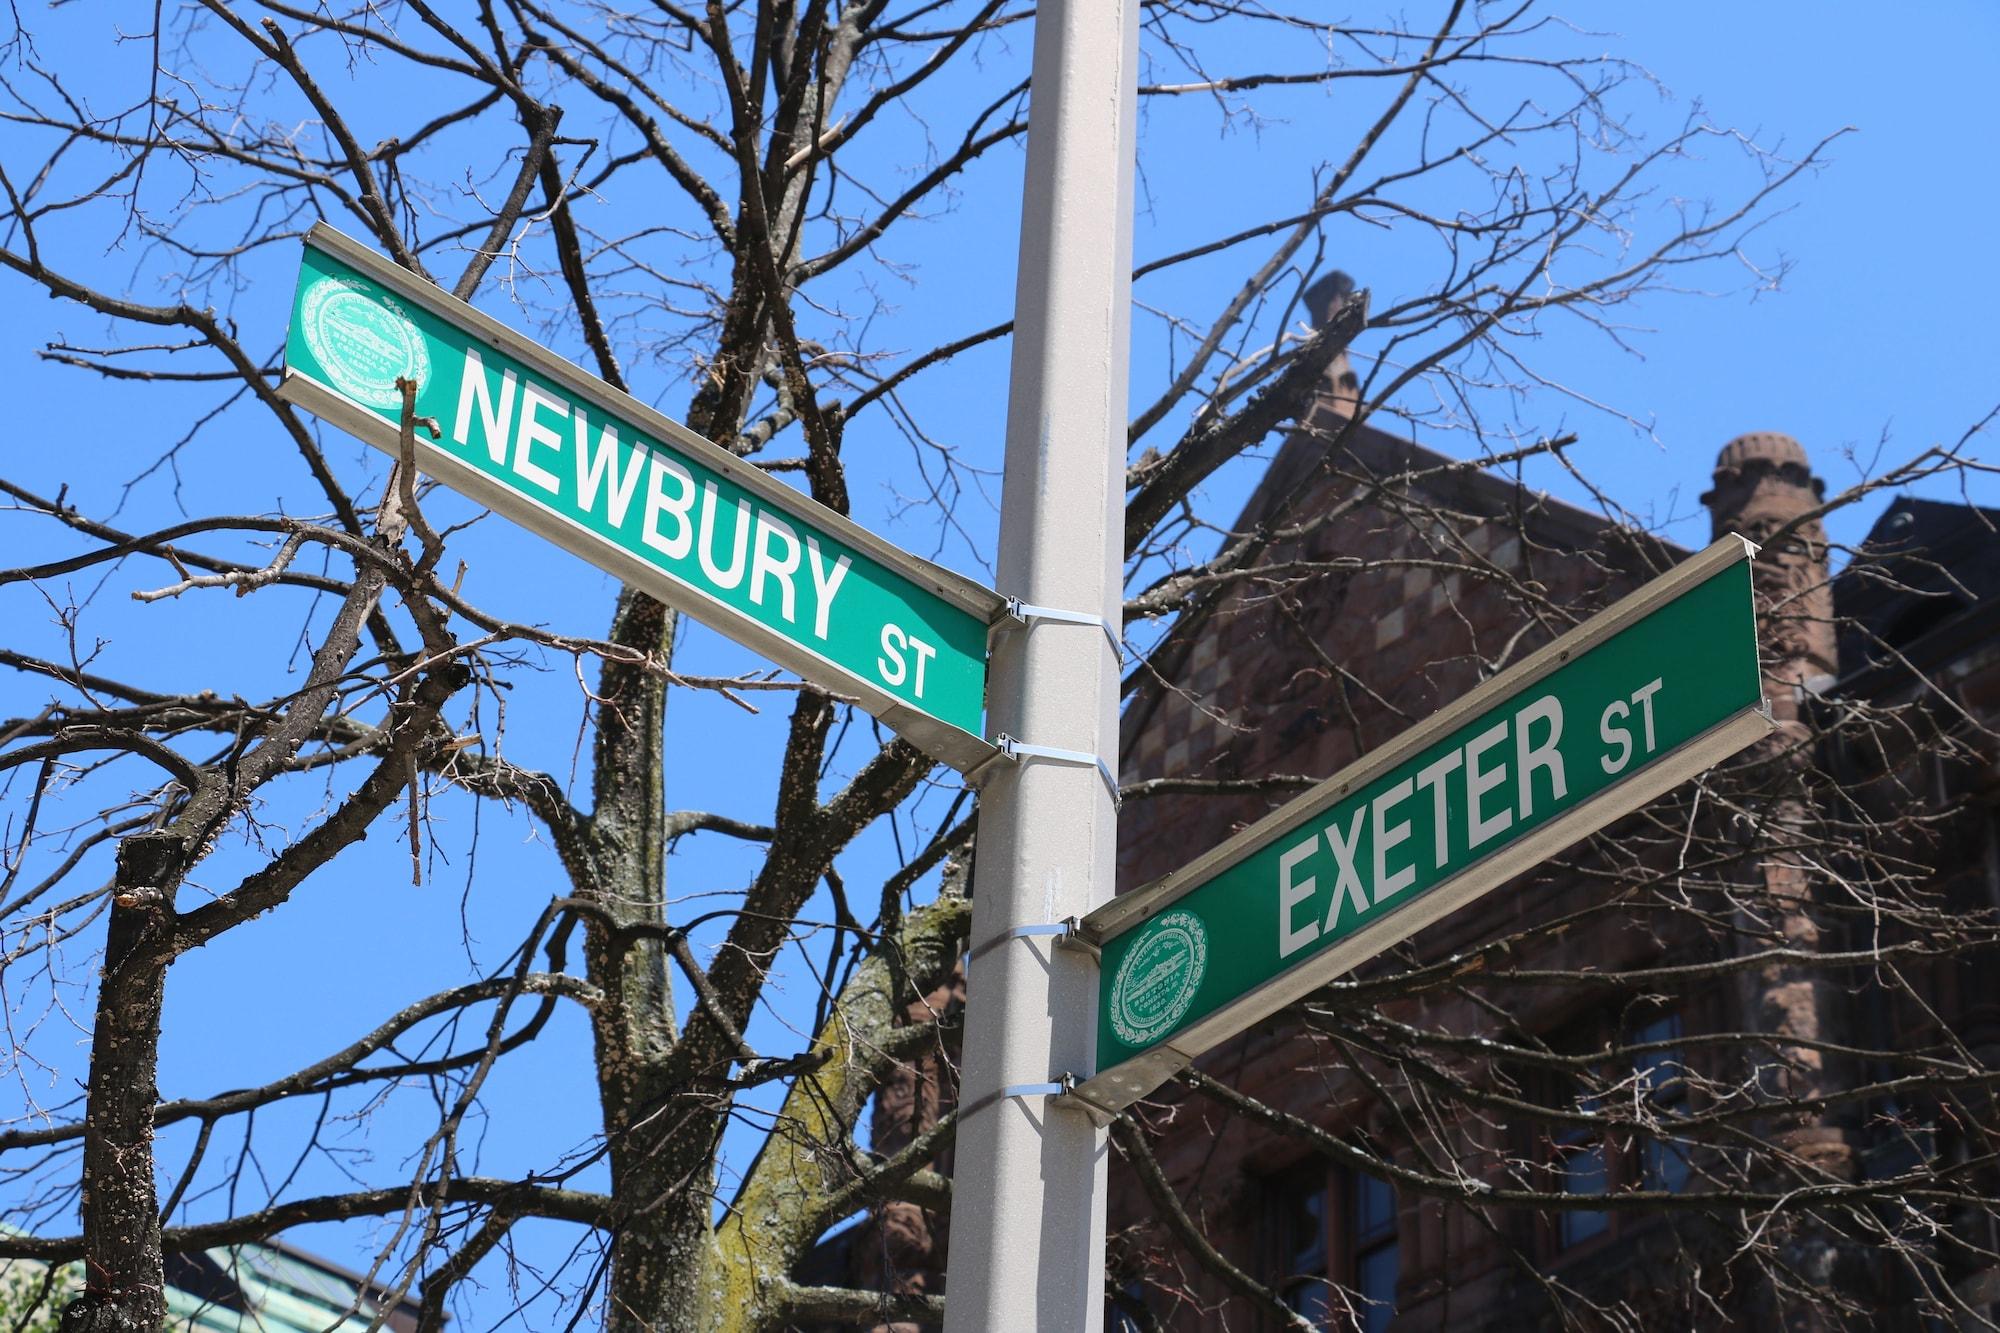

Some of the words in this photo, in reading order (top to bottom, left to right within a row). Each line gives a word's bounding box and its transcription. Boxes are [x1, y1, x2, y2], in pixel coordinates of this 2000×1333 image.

[453, 348, 853, 641] NEWBURY
[877, 623, 937, 699] ST
[1279, 695, 1568, 959] EXETER
[1600, 677, 1663, 774] ST
[1134, 972, 1180, 1007] BOSTONIA
